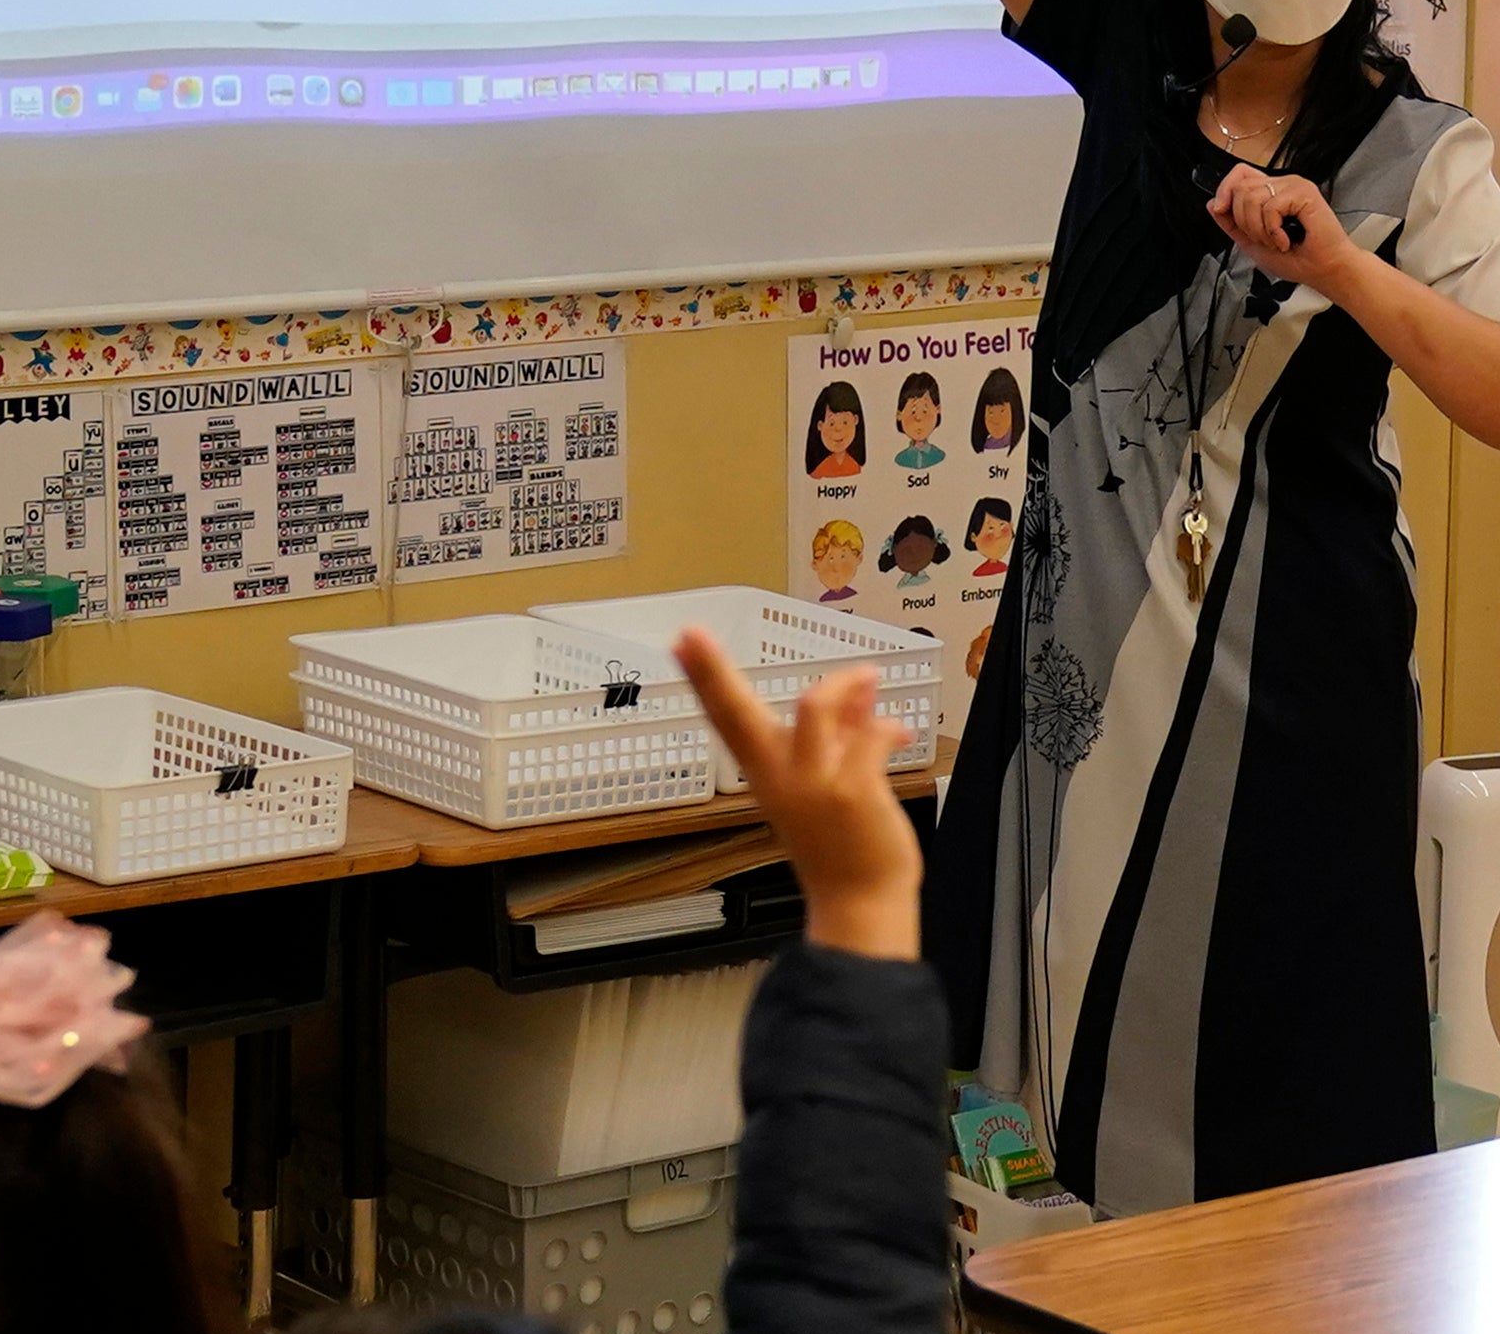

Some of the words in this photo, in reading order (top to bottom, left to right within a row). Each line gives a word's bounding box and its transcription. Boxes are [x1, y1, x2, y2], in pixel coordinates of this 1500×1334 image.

[820, 345, 872, 369] How
[879, 339, 911, 364] Do
[917, 334, 958, 360] You
[965, 327, 1011, 354] Feel
[411, 365, 510, 393] SOUND
[521, 356, 599, 384] WALL
[138, 383, 248, 412] SOUND
[261, 373, 346, 400] WALL
[908, 473, 930, 488] Sad
[989, 465, 1010, 480] Shy
[817, 484, 857, 500] Happy
[903, 594, 936, 611] Proud
[662, 1159, 689, 1185] 102
